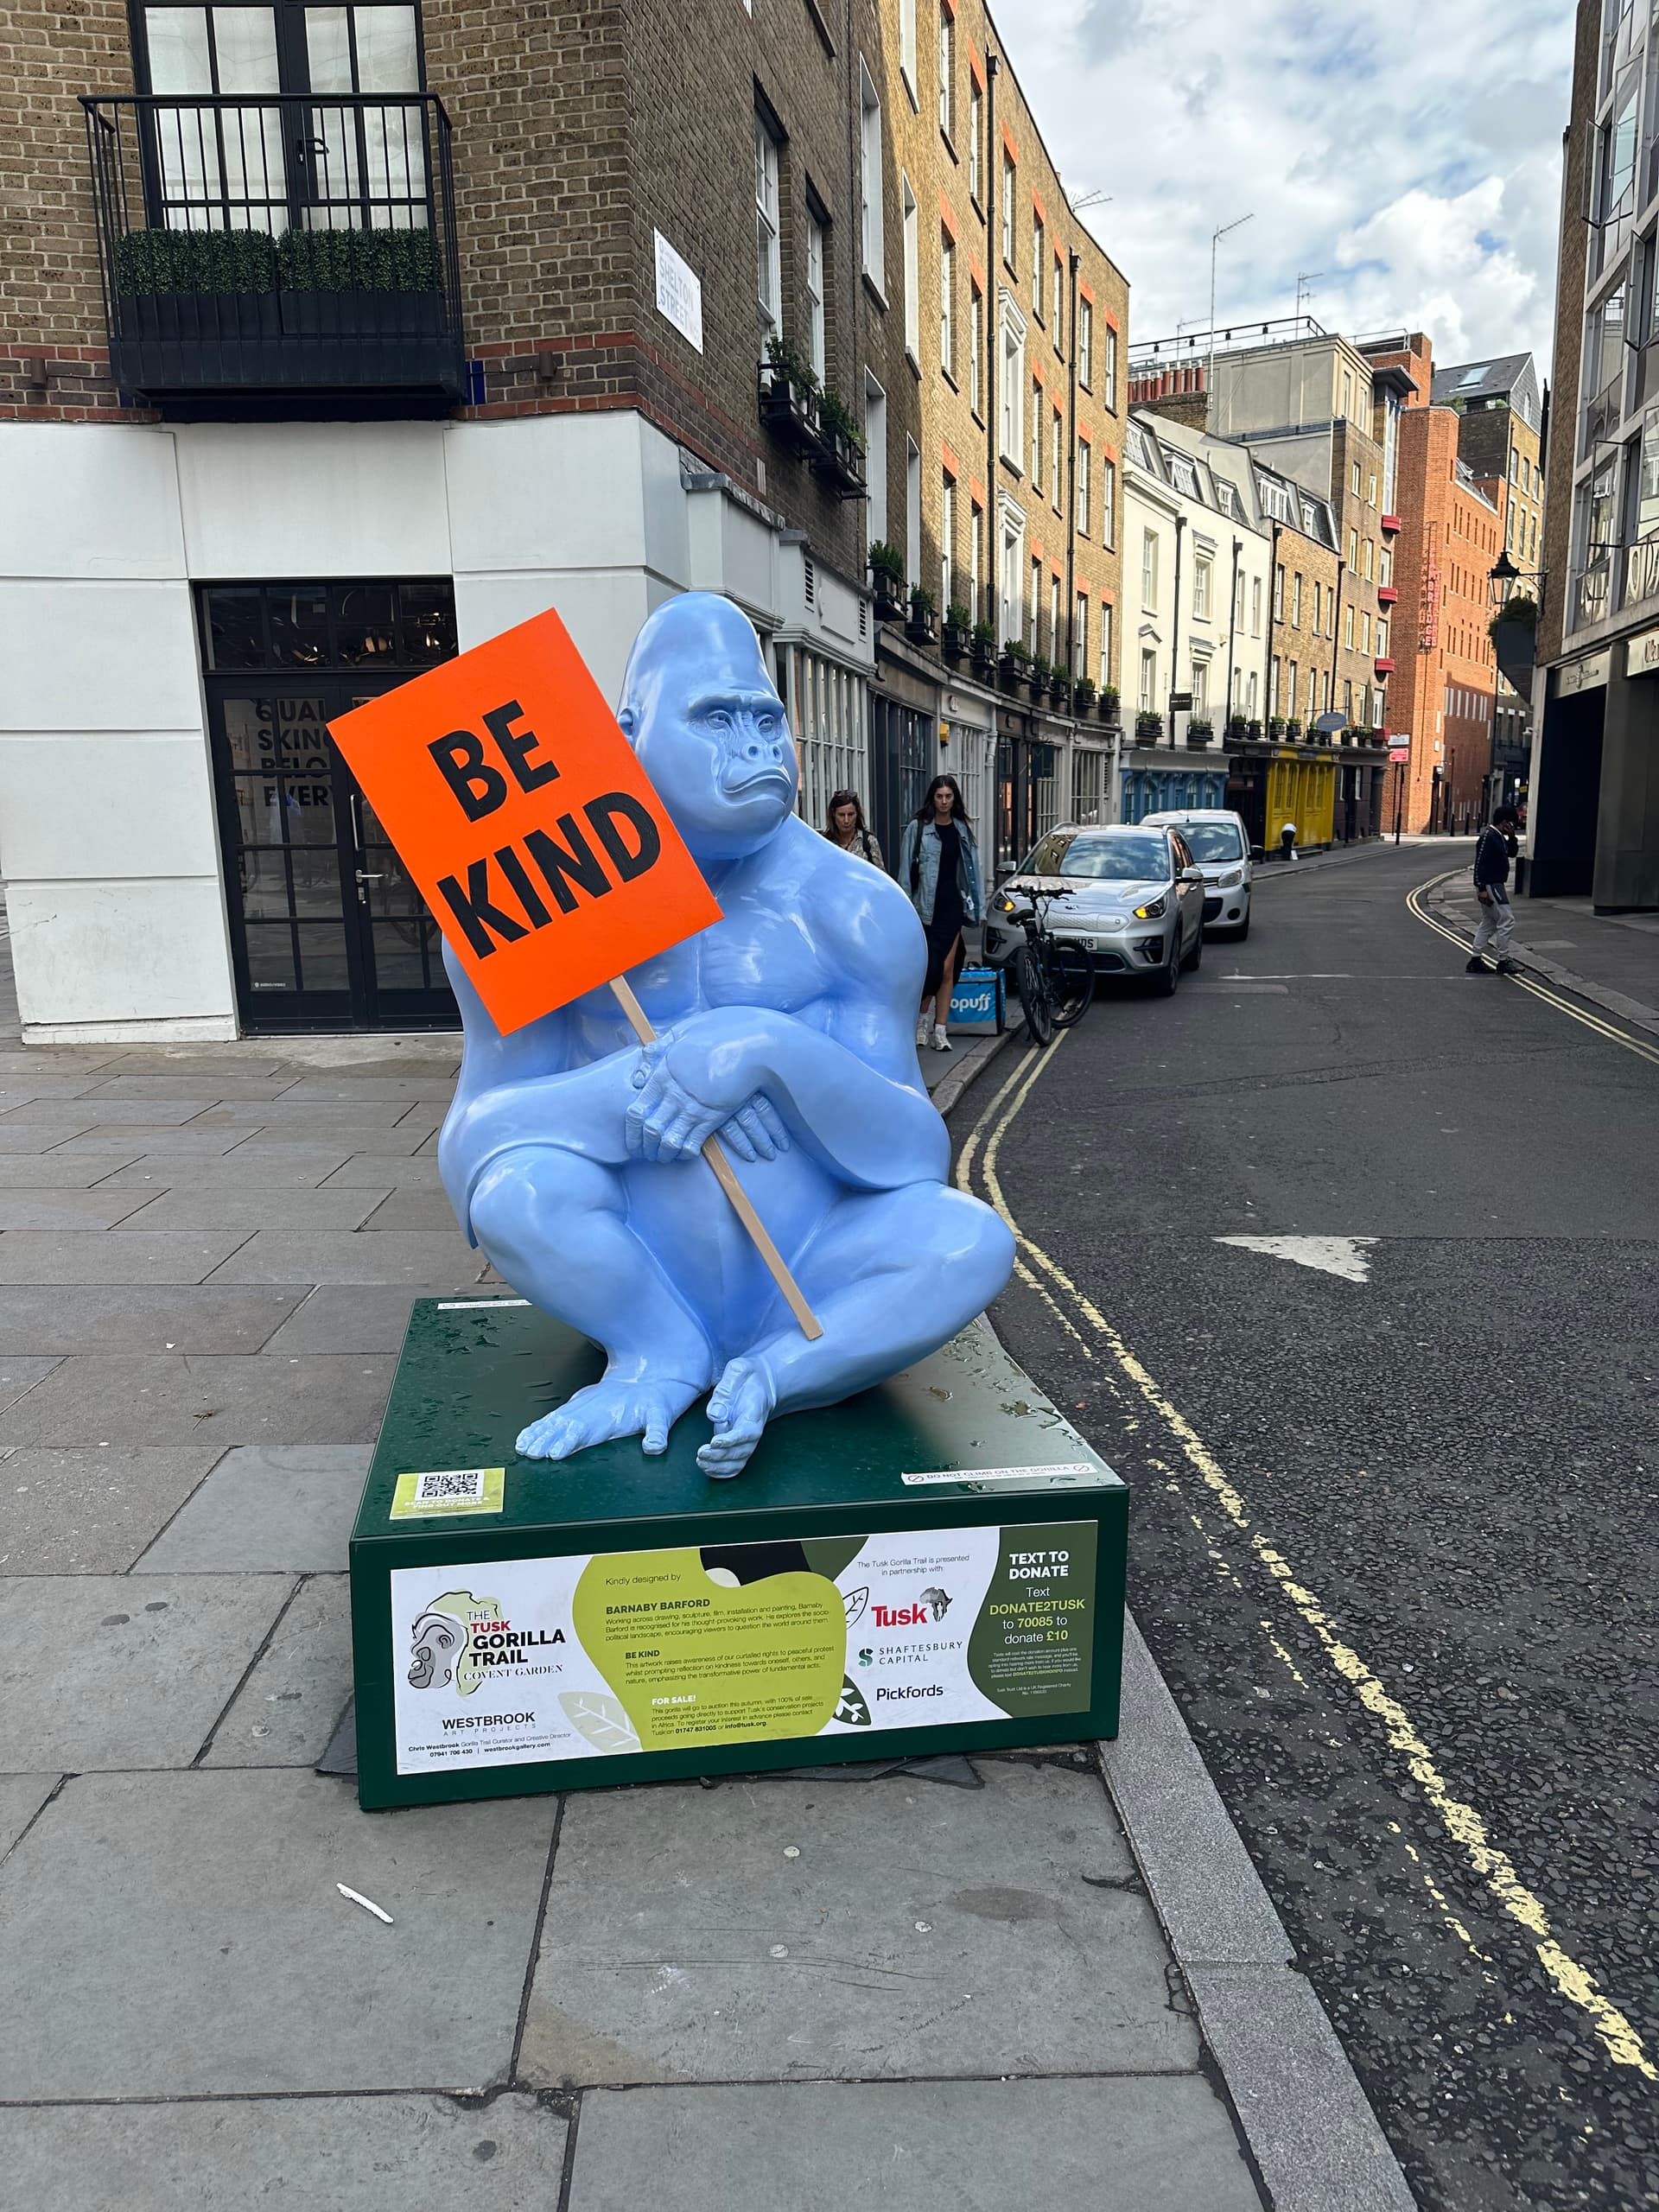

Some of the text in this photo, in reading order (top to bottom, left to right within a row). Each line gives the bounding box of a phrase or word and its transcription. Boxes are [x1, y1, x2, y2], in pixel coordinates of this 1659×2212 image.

[659, 257, 694, 311] SHELTON
[659, 284, 689, 330] STREET
[427, 699, 562, 823] BE
[436, 791, 661, 960] KIND
[936, 1555, 969, 1564] presented
[1009, 1551, 1069, 1565] TEXT TO
[889, 1567, 927, 1576] partnership
[1009, 1565, 1069, 1580] DONATE
[606, 1573, 681, 1586] Kindly designed by
[1026, 1587, 1050, 1598] Text
[607, 1599, 710, 1615] BARNABY BARFORD
[990, 1599, 1084, 1615] DONATE2TUSK
[467, 1611, 490, 1621] THE
[872, 1604, 927, 1627] Tusk
[470, 1621, 511, 1633] TUSK
[1002, 1616, 1068, 1630] to 70085 to
[474, 1630, 565, 1649] GORILLA
[1005, 1630, 1068, 1644] donate £10
[880, 1642, 963, 1655] SHAFTESBURY
[469, 1649, 528, 1667] TRAIL
[880, 1655, 928, 1665] CAPITAL
[464, 1665, 563, 1681] COVENT GARDEN
[877, 1685, 944, 1700] Pickfords
[652, 1695, 696, 1706] FOR SALE!
[442, 1713, 535, 1729] WESTBROOK
[474, 1723, 536, 1733] PROJECTS
[485, 1743, 550, 1752] westbrookgallery.com
